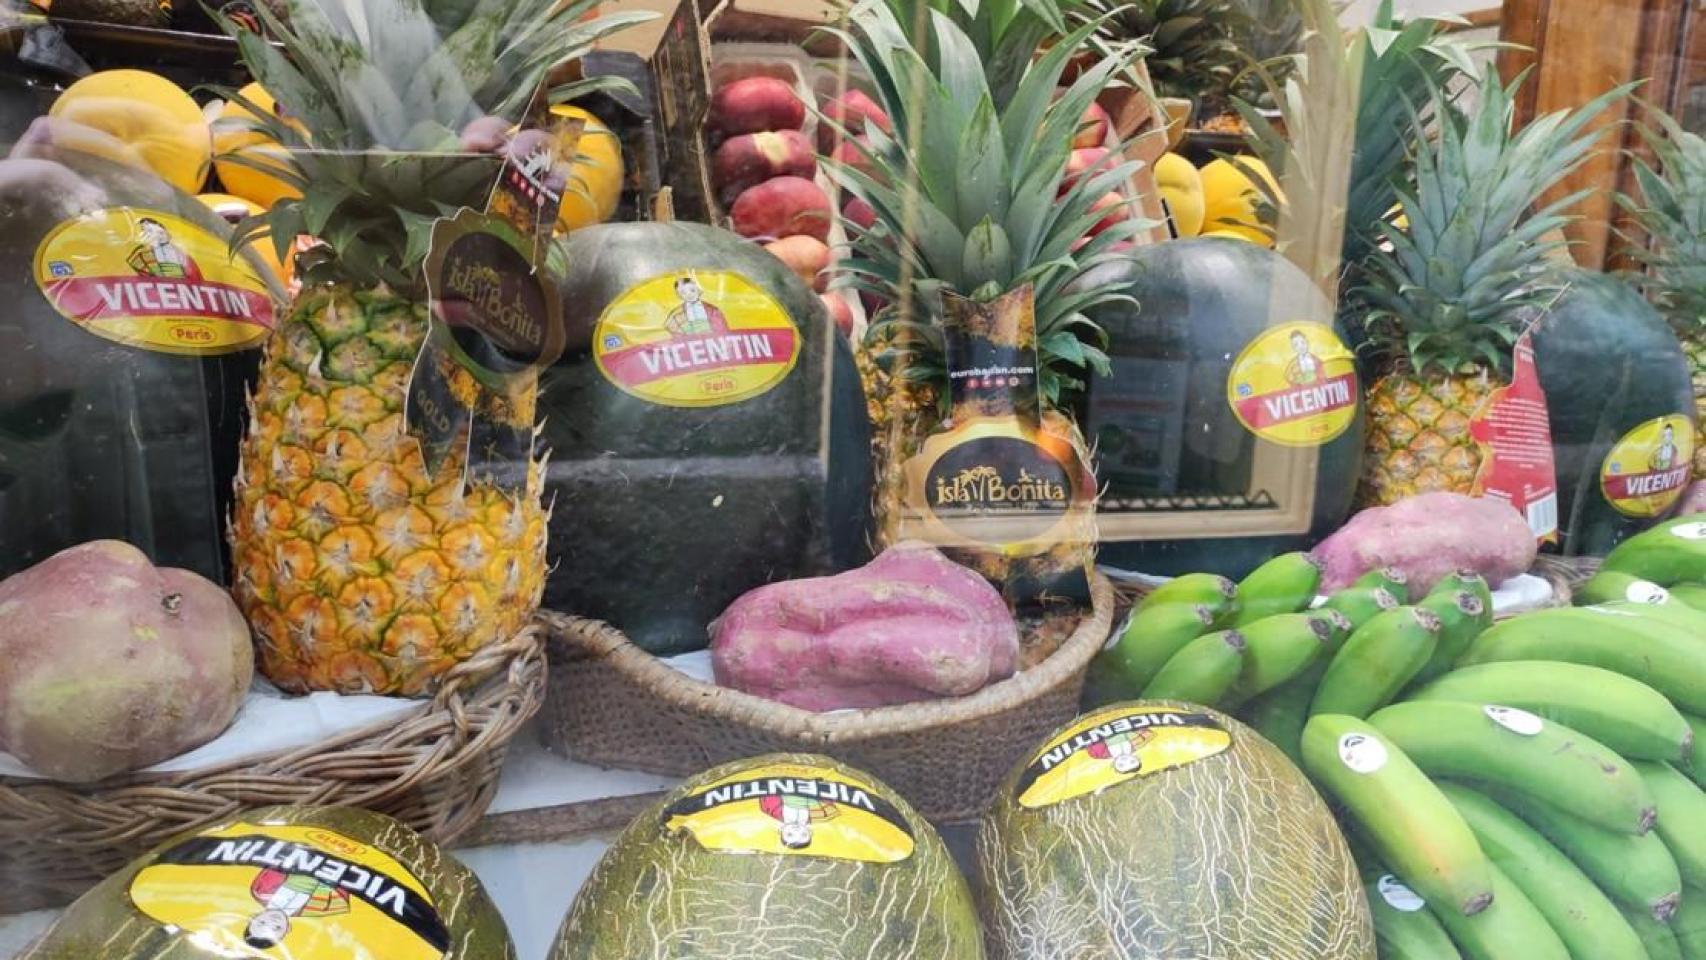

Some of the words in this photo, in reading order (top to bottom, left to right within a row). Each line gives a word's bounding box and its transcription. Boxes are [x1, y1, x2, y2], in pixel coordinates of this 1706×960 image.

[96, 282, 252, 317] VICENTIN
[639, 334, 774, 375] VICENTIN
[417, 389, 451, 432] GOLD
[1264, 379, 1349, 420] VICENTIN
[987, 475, 1065, 501] Bonita
[1041, 713, 1185, 770] VICENTIN
[705, 778, 876, 811] VICENTIN
[206, 839, 407, 916] VICENTIN
